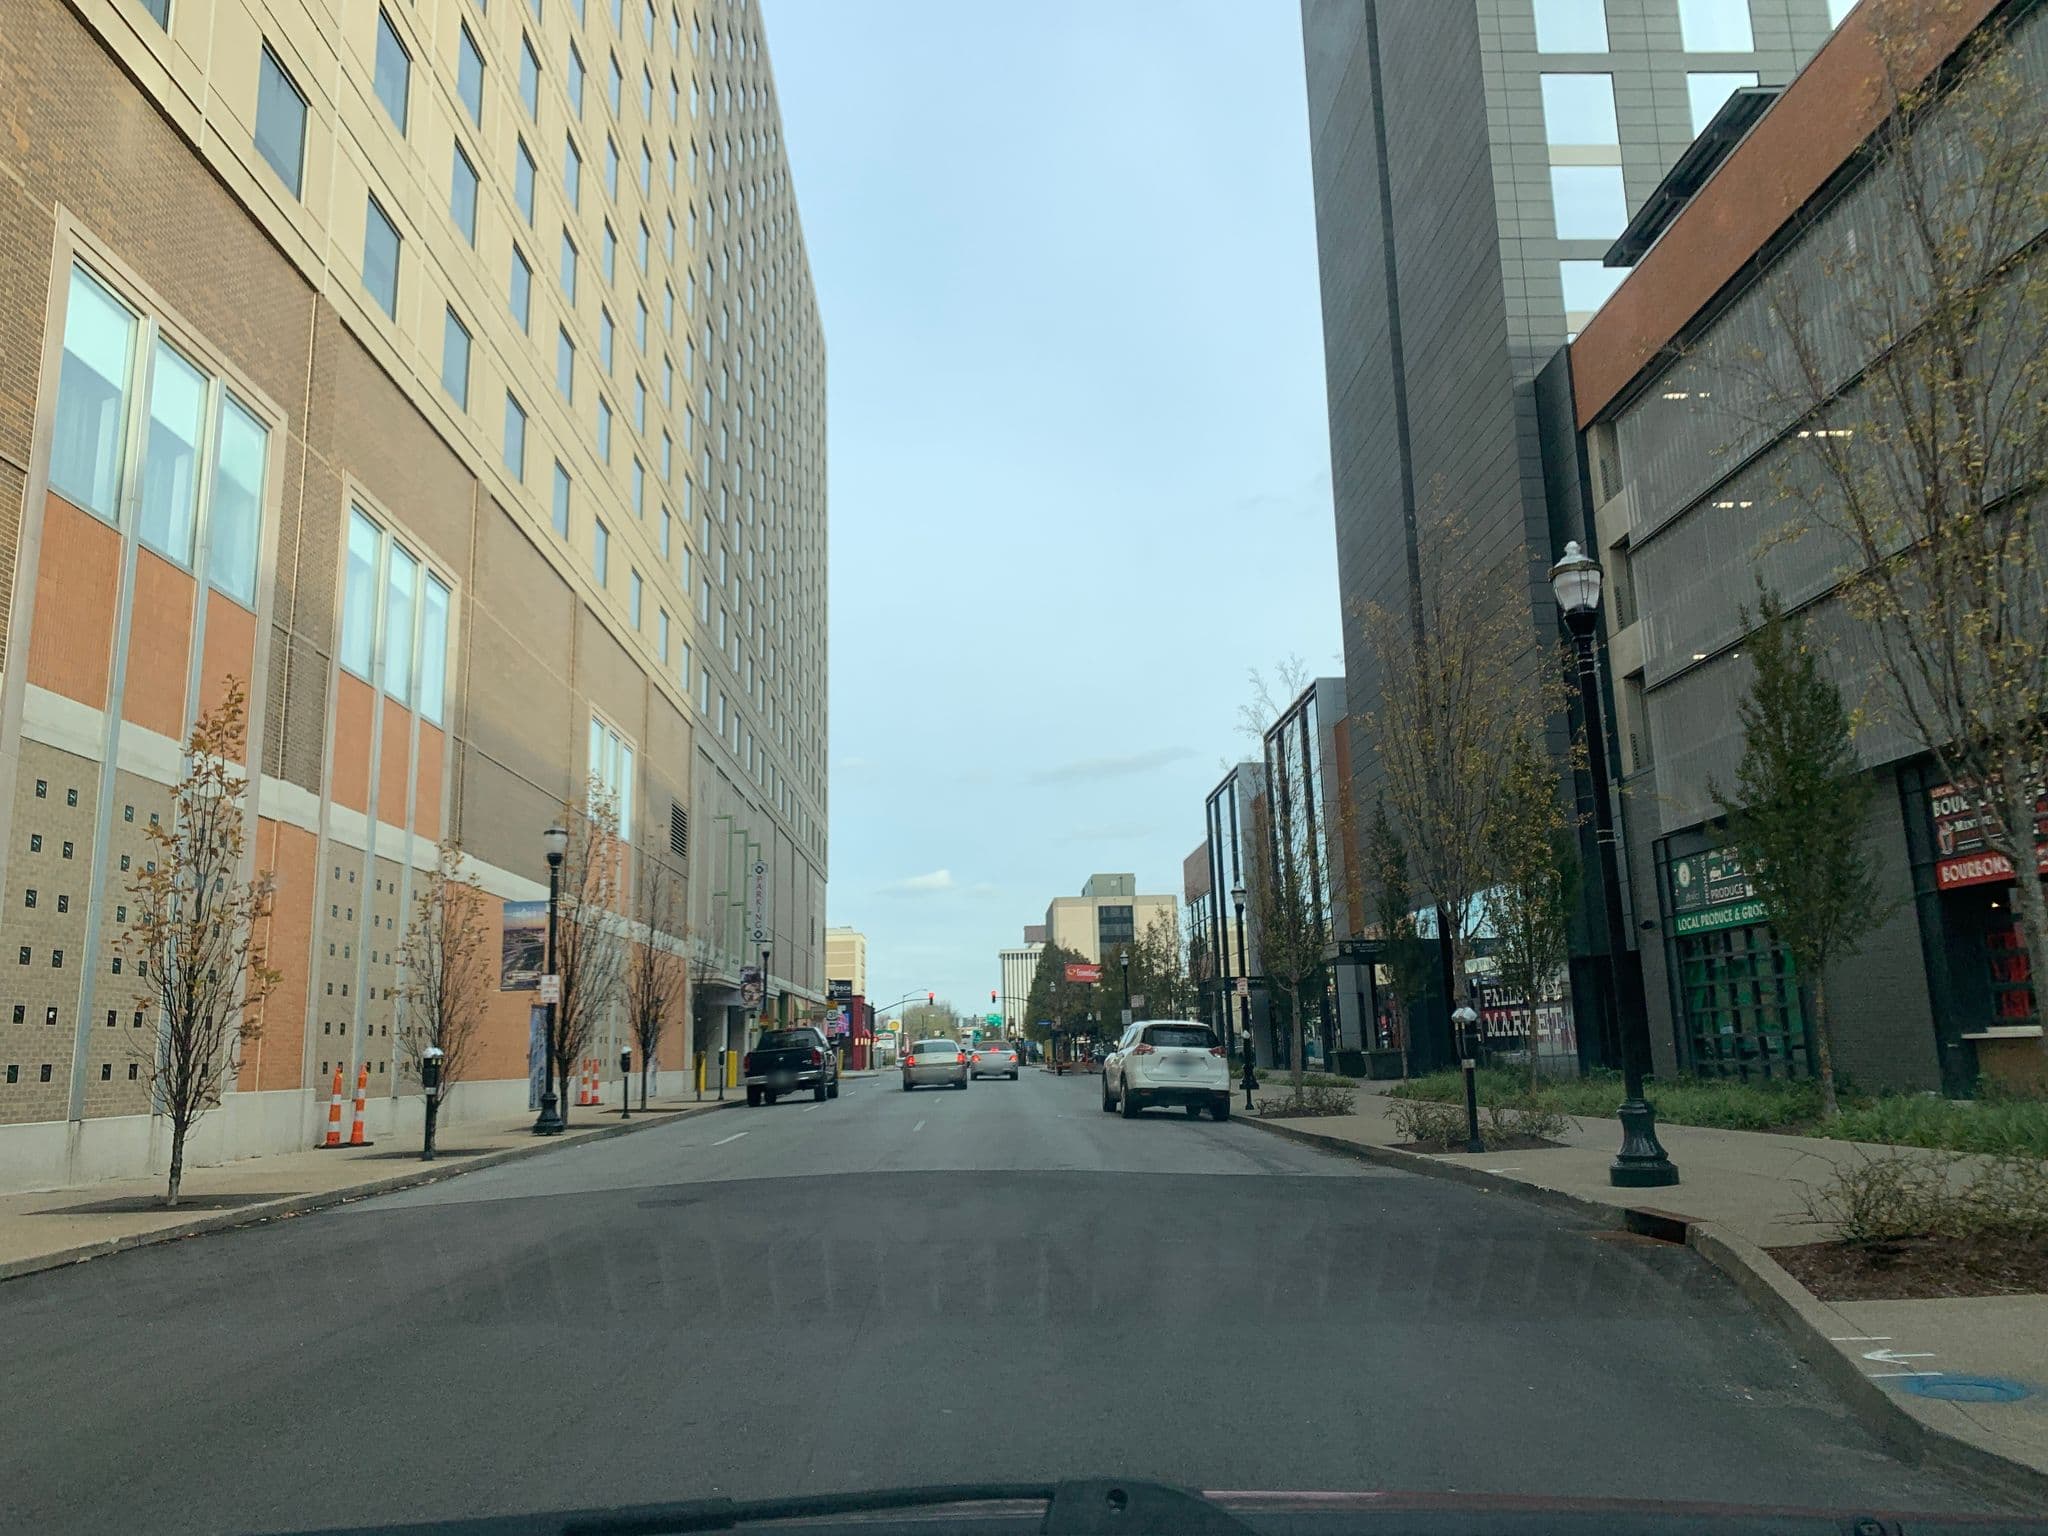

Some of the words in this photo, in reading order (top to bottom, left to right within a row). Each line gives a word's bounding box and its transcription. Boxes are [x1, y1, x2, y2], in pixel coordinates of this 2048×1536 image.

[755, 875, 763, 929] PARKING
[1710, 883, 1744, 900] PRODUCE
[1677, 914, 1700, 931] LOCAL
[1701, 909, 1733, 926] PRODUCE
[1735, 908, 1741, 920] &
[1483, 987, 1524, 1007] FALLS
[1485, 1007, 1562, 1037] MARKET
